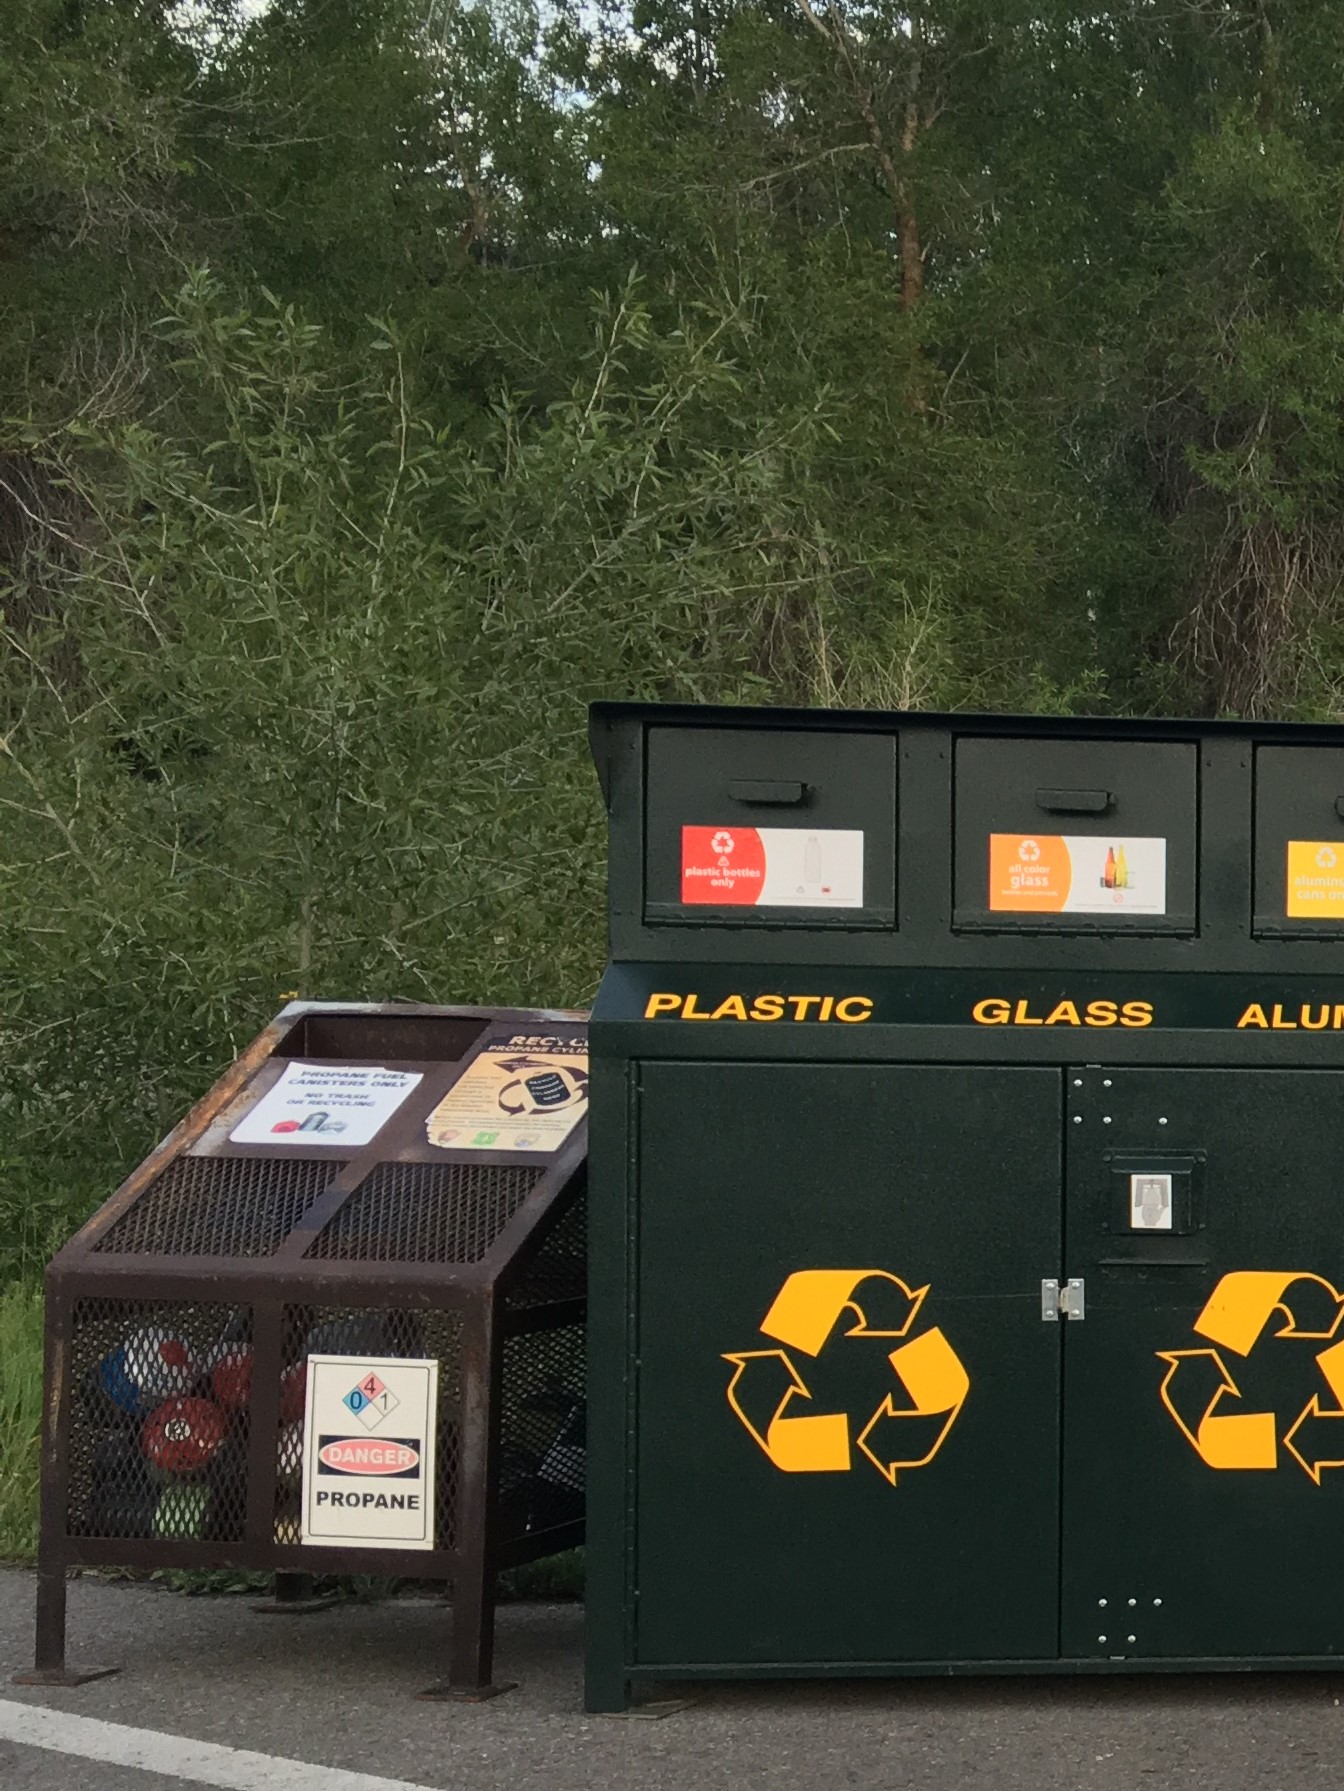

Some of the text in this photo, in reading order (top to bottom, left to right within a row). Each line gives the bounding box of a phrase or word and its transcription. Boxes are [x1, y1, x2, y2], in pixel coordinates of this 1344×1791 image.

[685, 866, 761, 878] plastic bottles
[1008, 864, 1050, 873] all color
[710, 877, 735, 889] only
[1010, 873, 1049, 889] glass
[1297, 889, 1325, 900] cans
[644, 993, 874, 1023] PLASTIC
[972, 998, 1154, 1027] GLASS
[487, 1045, 549, 1053] PROPANE
[301, 1071, 408, 1080] PROPANE FUEL
[288, 1079, 366, 1087] CANISTERS
[364, 1377, 376, 1394] 4
[350, 1391, 388, 1411] 0 1
[328, 1446, 411, 1466] DANGER
[316, 1490, 420, 1511] PROPANE
